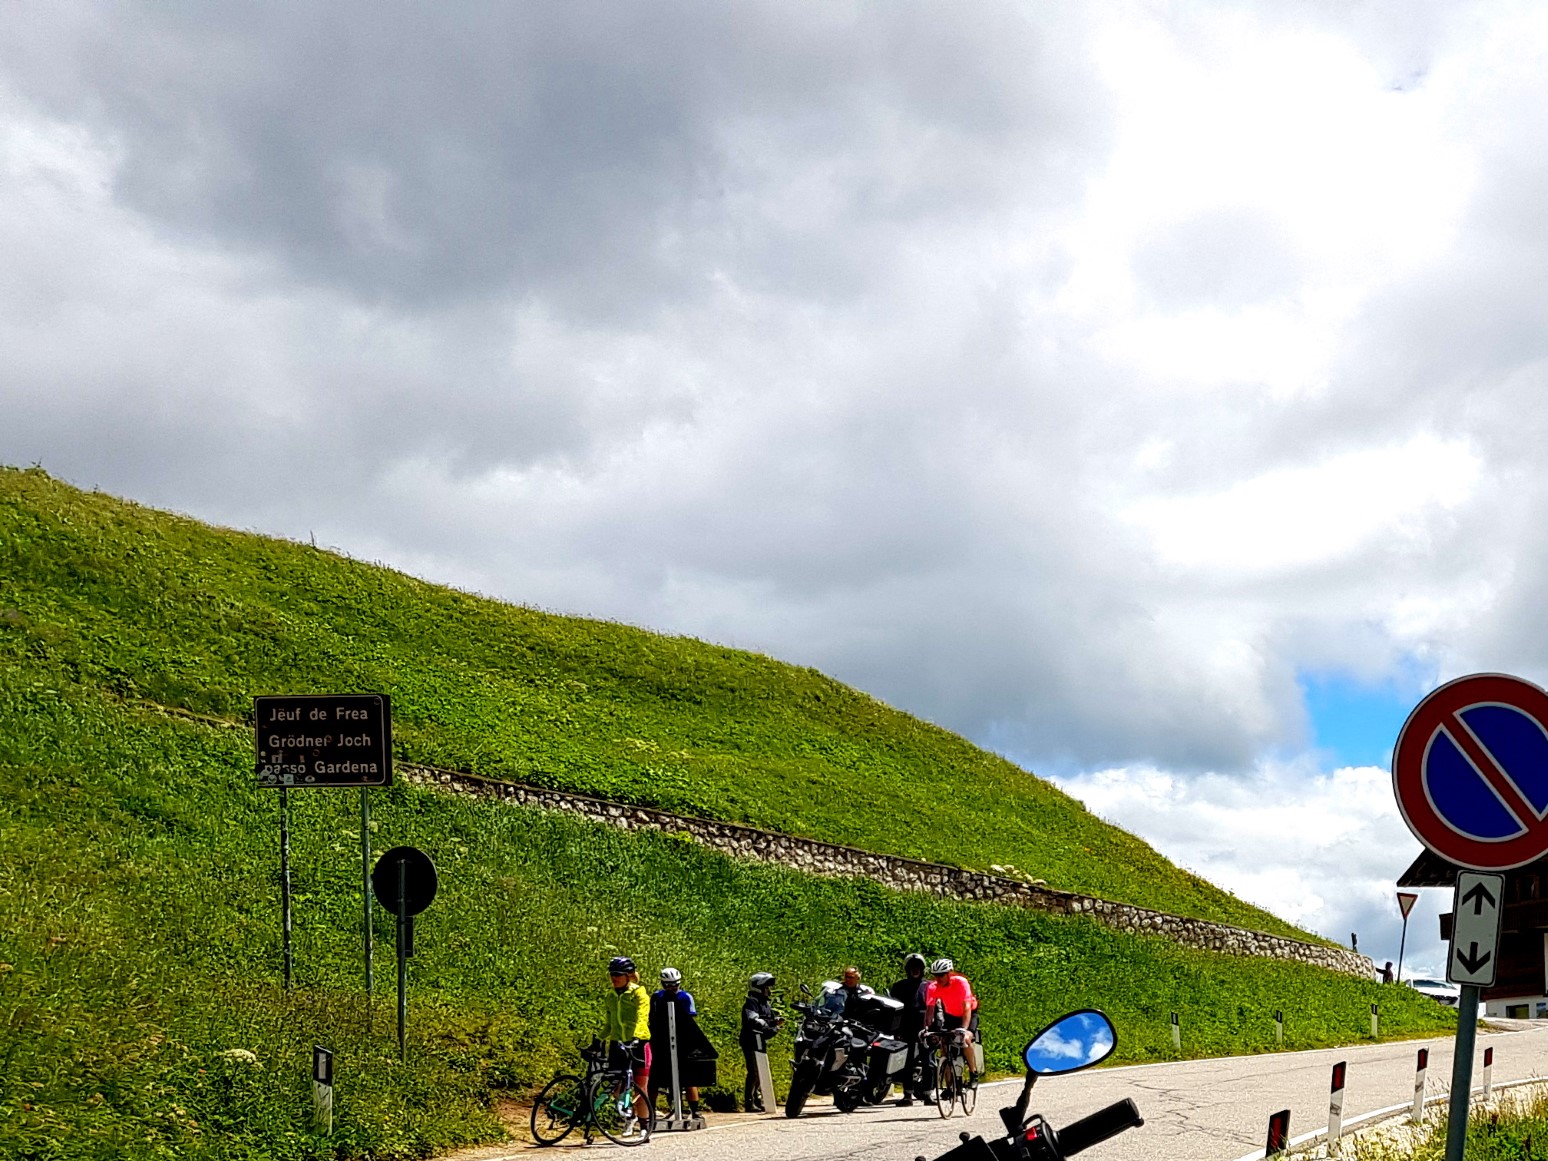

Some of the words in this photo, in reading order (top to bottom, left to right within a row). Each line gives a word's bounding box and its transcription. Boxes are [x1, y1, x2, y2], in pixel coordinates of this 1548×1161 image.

[269, 707, 301, 721] Jëuf
[309, 707, 327, 720] de
[336, 706, 368, 720] Frea
[337, 733, 371, 747] Joch
[314, 760, 378, 774] Gardena
